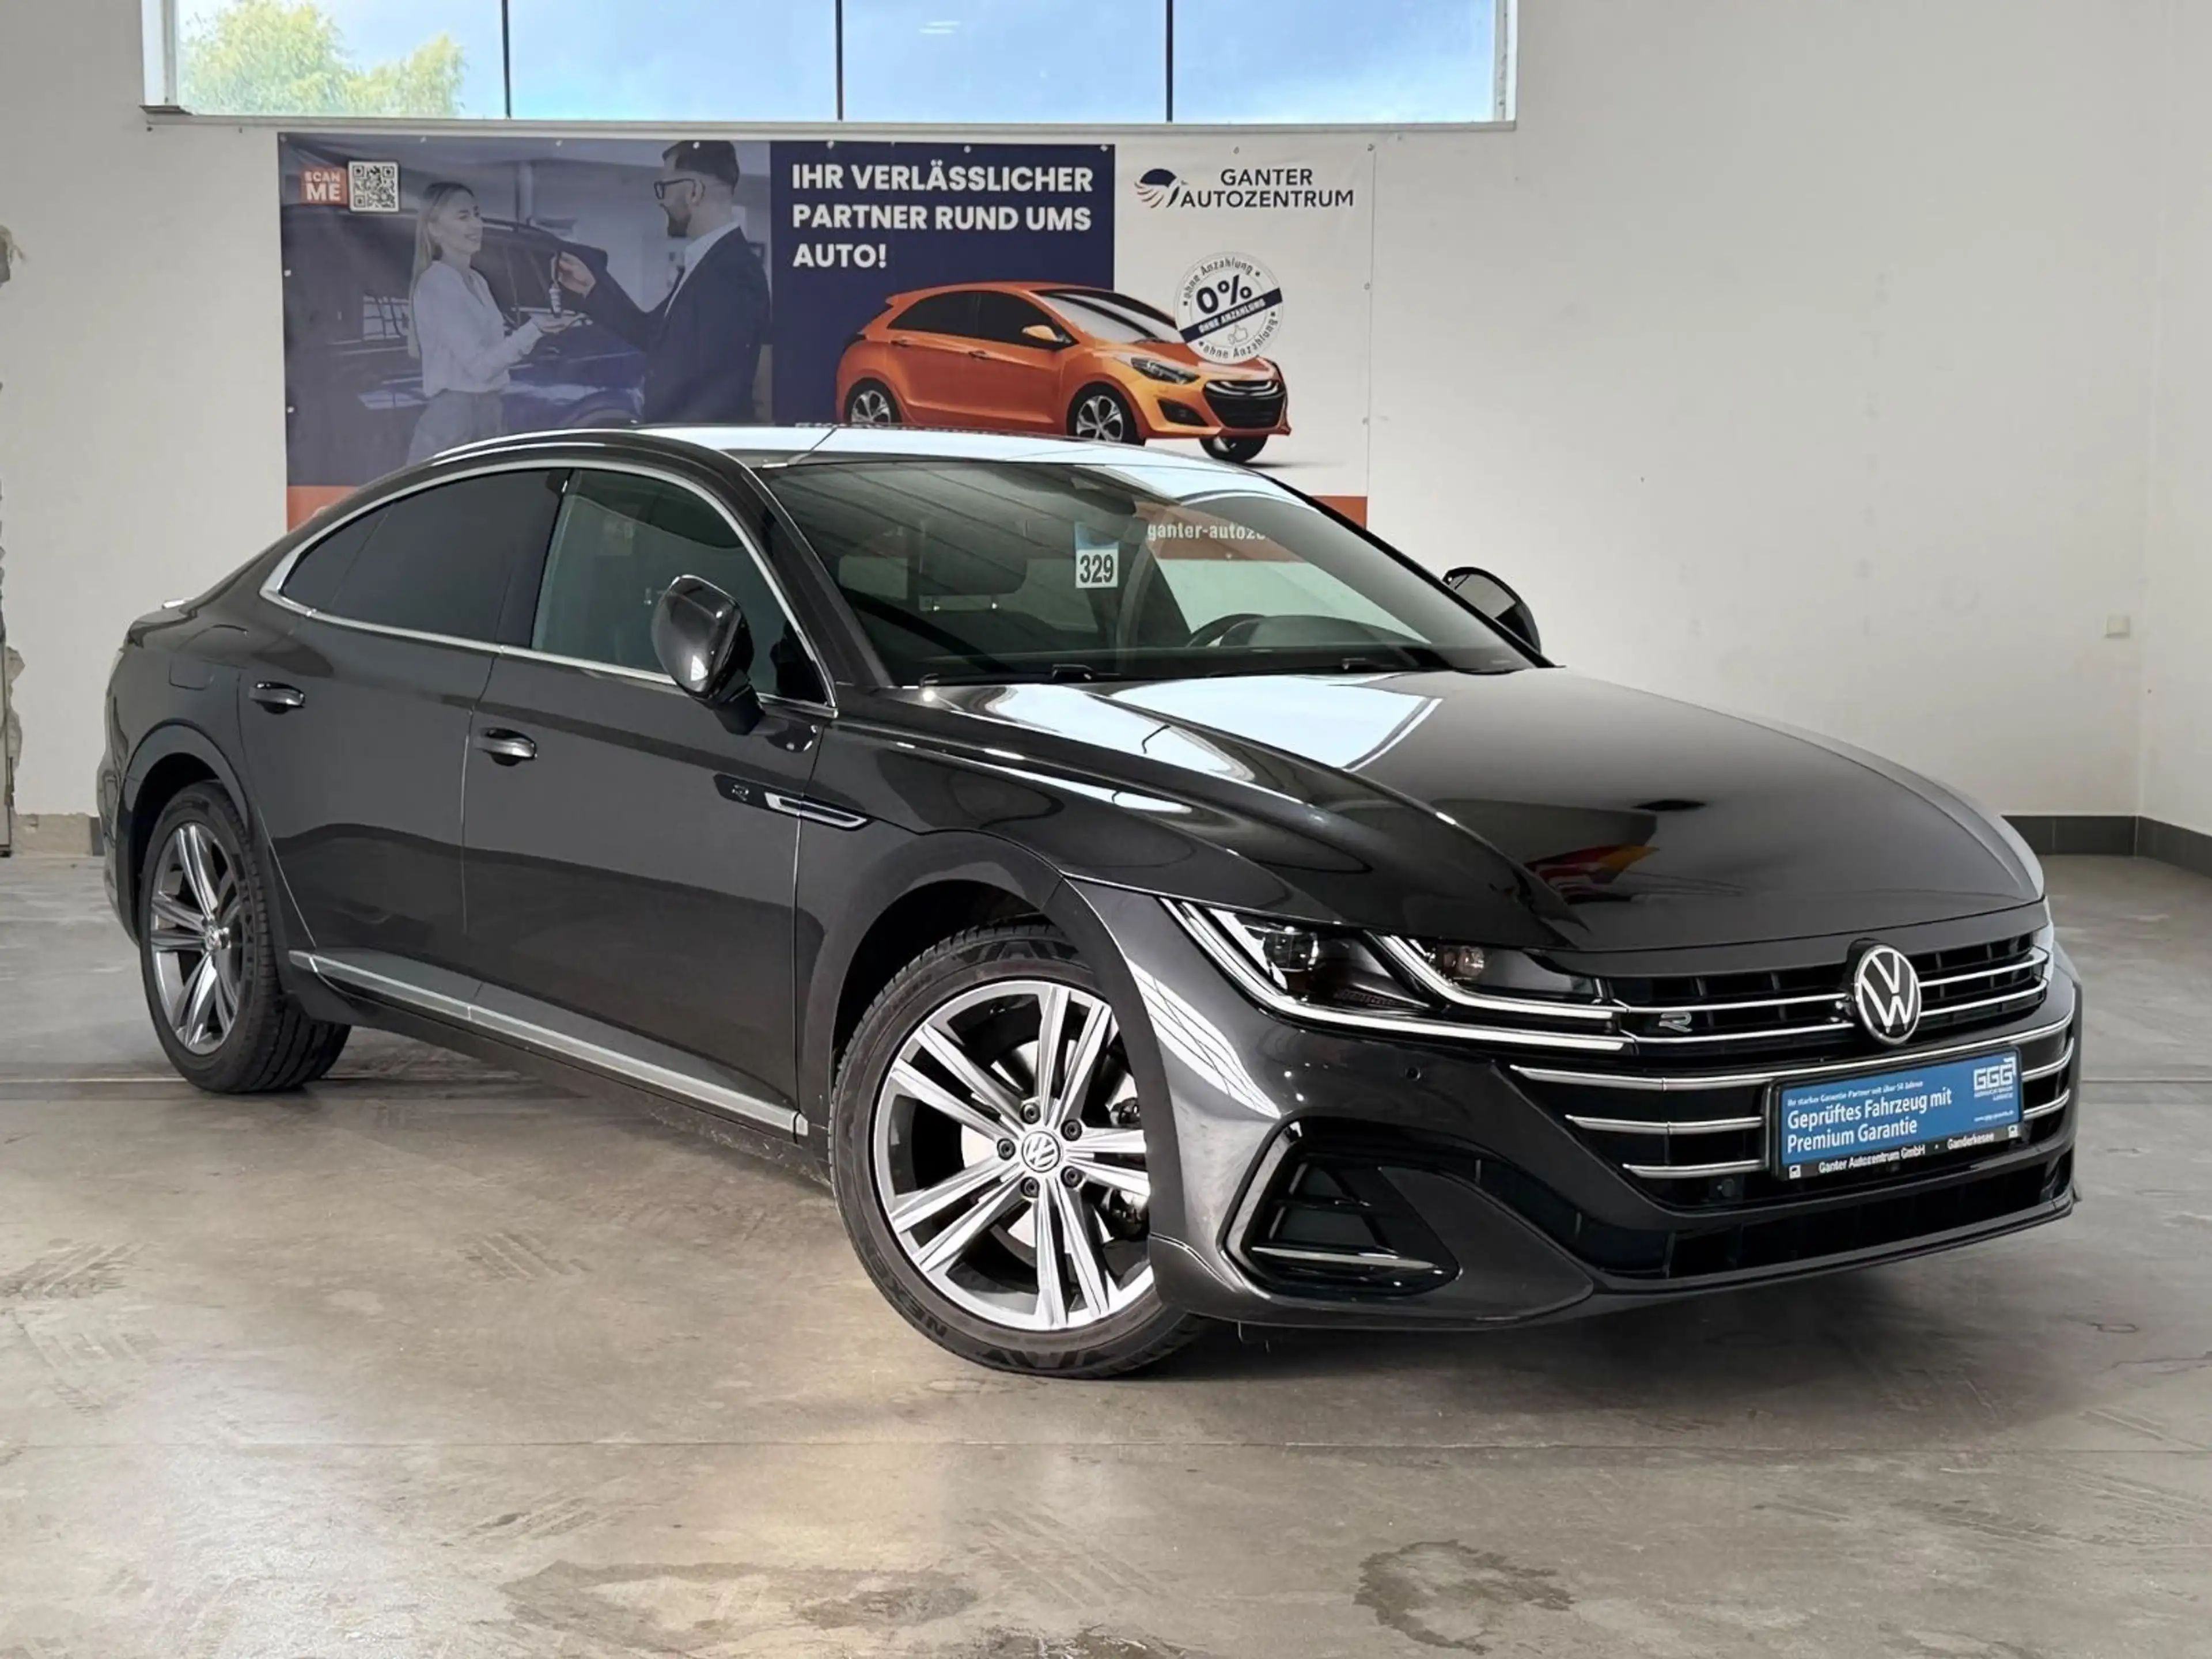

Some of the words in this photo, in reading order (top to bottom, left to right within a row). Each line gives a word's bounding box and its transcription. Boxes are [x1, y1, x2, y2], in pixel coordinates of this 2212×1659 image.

[304, 171, 340, 182] SCAN
[792, 164, 844, 189] IHR
[850, 159, 1093, 192] VERLÄSSLICHER
[1220, 168, 1313, 186] GANTER
[306, 181, 342, 201] ME
[1180, 189, 1354, 208] AUTOZENTRUM
[793, 203, 928, 229] PARTNER
[935, 205, 1019, 230] RUND
[1025, 206, 1092, 231] UMS
[792, 243, 887, 268] AUTO!
[1200, 257, 1254, 276] Anzahlung
[1196, 274, 1252, 315] 0%
[1220, 298, 1267, 324] ANZAHLUNG
[1233, 319, 1279, 359] Anzahlung
[1080, 554, 1114, 584] 329
[1974, 1062, 2014, 1090] GGG
[1787, 1103, 1862, 1132] Geprüftes
[1864, 1096, 1928, 1114] Fahrzeug
[1930, 1086, 1952, 1107] mit
[1787, 1127, 1854, 1154] Premium
[1858, 1116, 1918, 1142] Garantie
[1819, 1159, 1847, 1174] Ganter
[1900, 1144, 1926, 1159] GmbH
